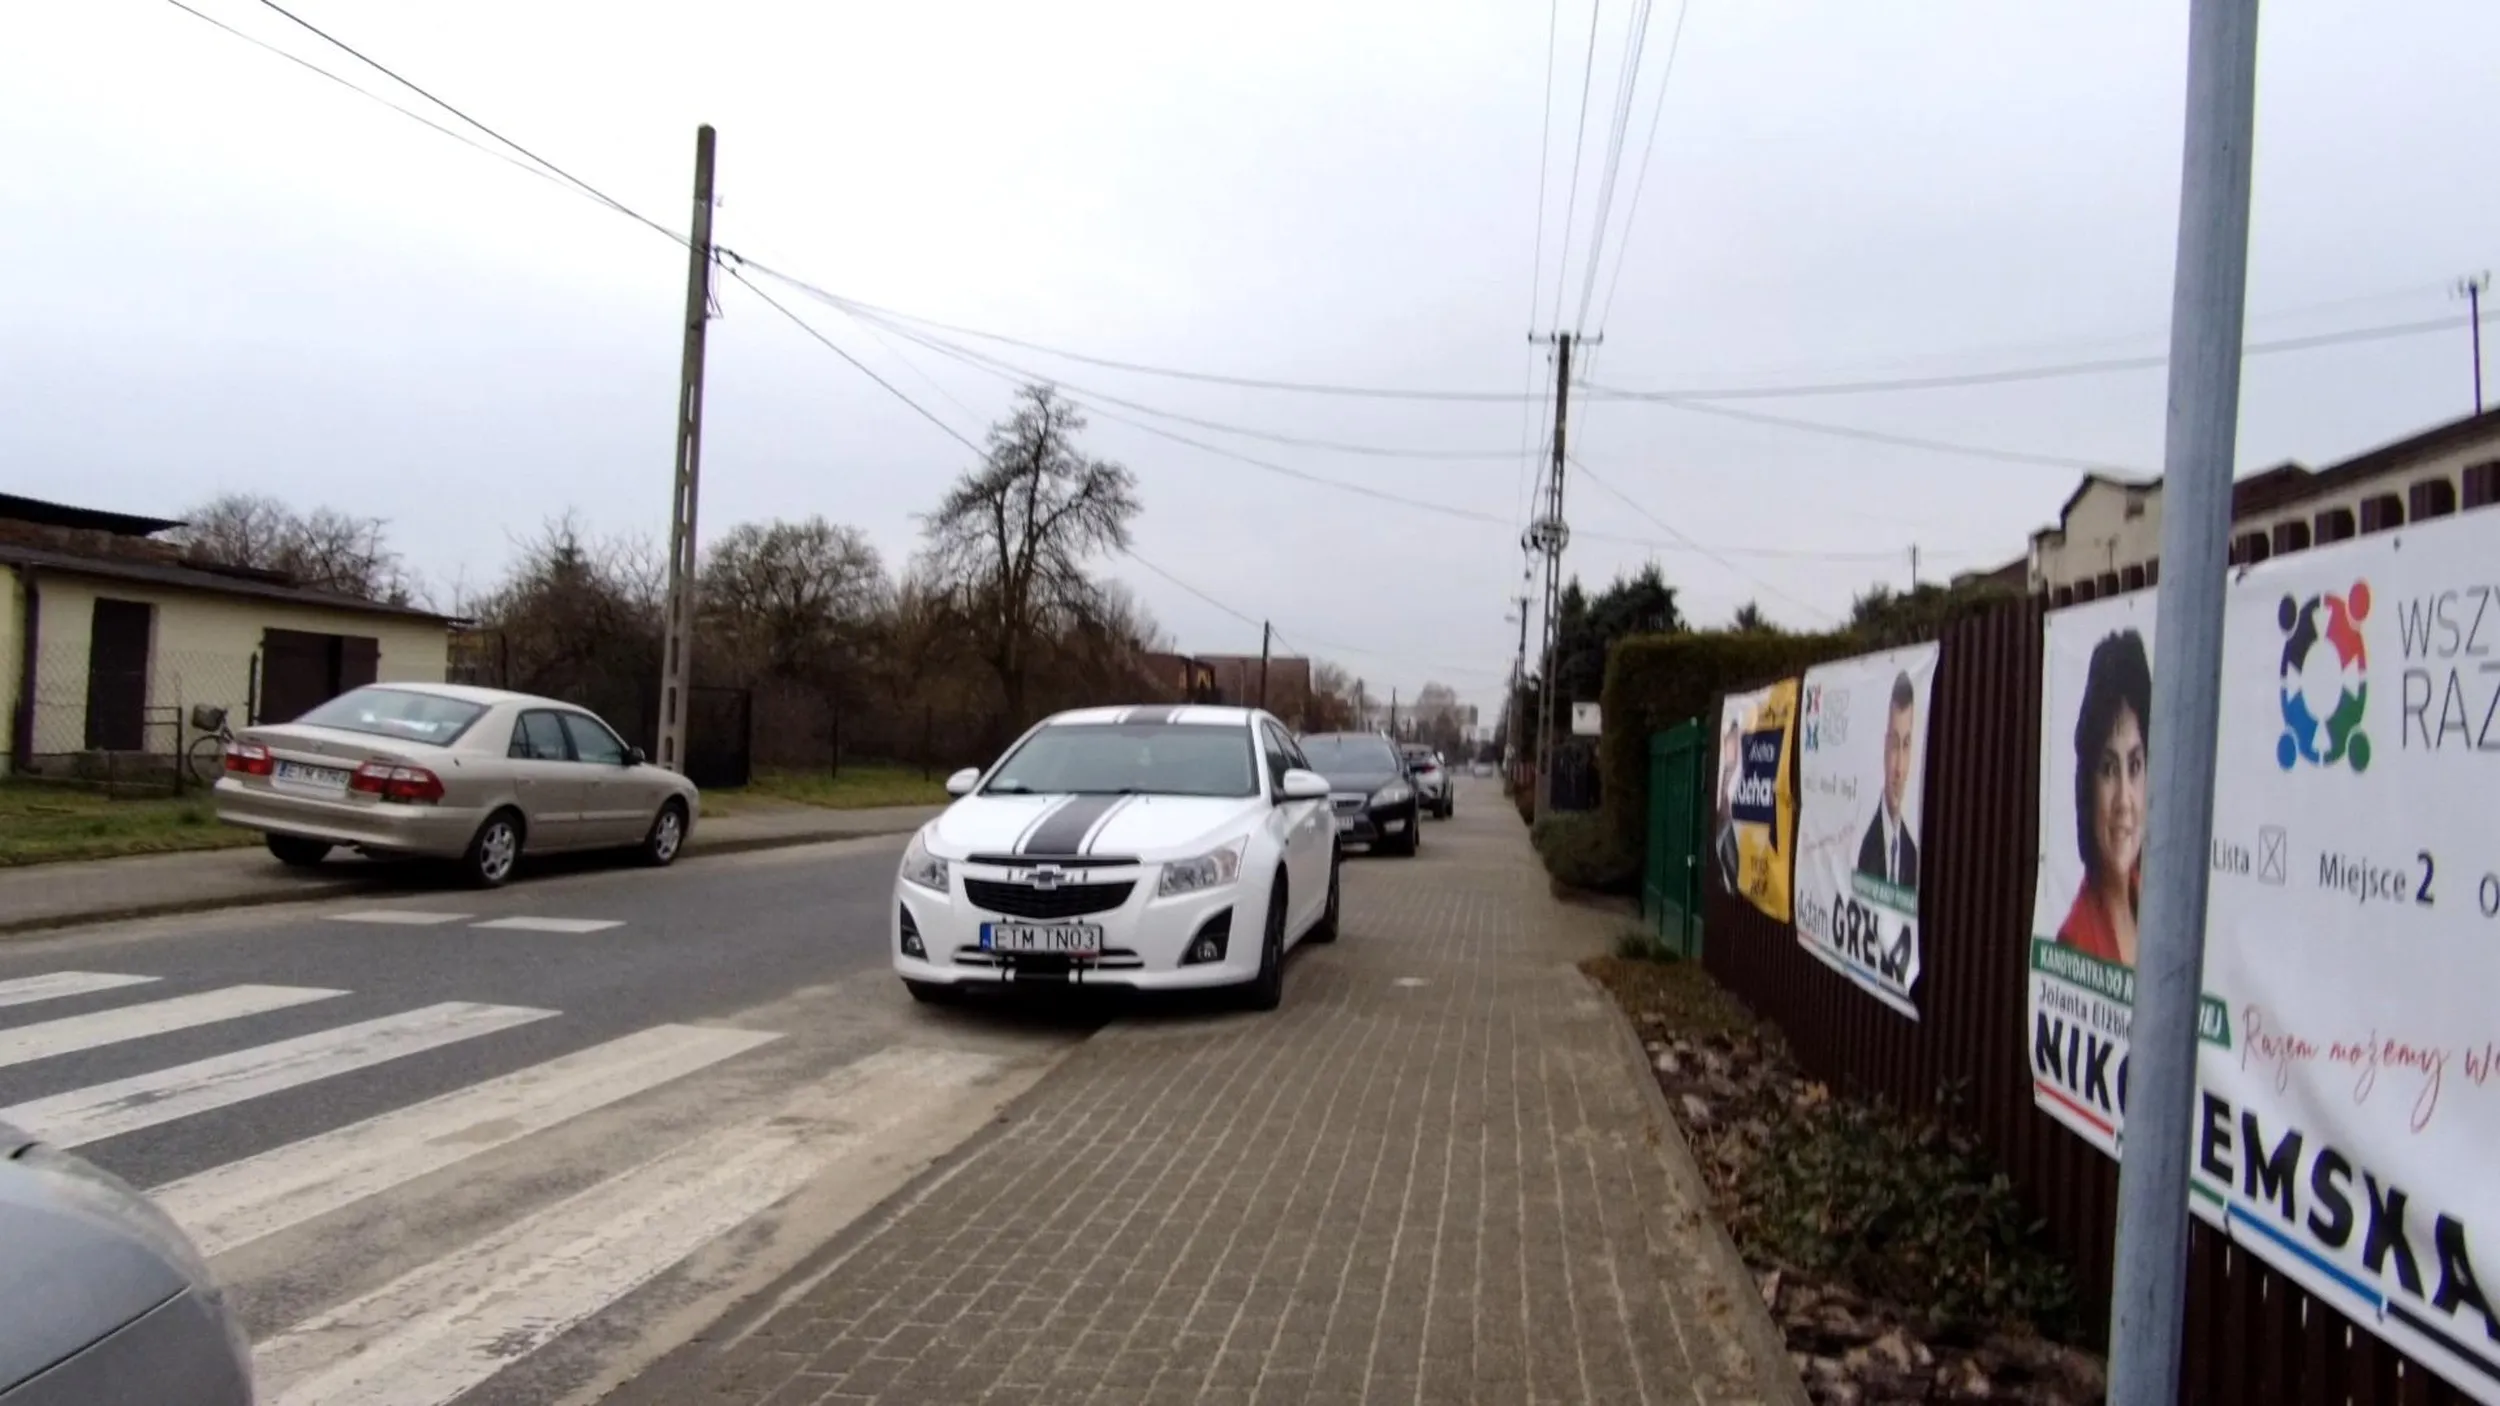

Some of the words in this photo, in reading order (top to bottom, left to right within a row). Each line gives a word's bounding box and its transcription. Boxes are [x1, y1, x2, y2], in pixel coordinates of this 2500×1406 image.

[2211, 838, 2250, 875] Lista
[2318, 850, 2407, 905] Miejsce
[2415, 850, 2436, 907] 2
[995, 926, 1034, 950] ETM
[1044, 926, 1095, 950] TN03
[2040, 944, 2105, 988] KANDYDATKA
[2040, 978, 2087, 1024] Jolanta
[2242, 1003, 2320, 1096] Razem
